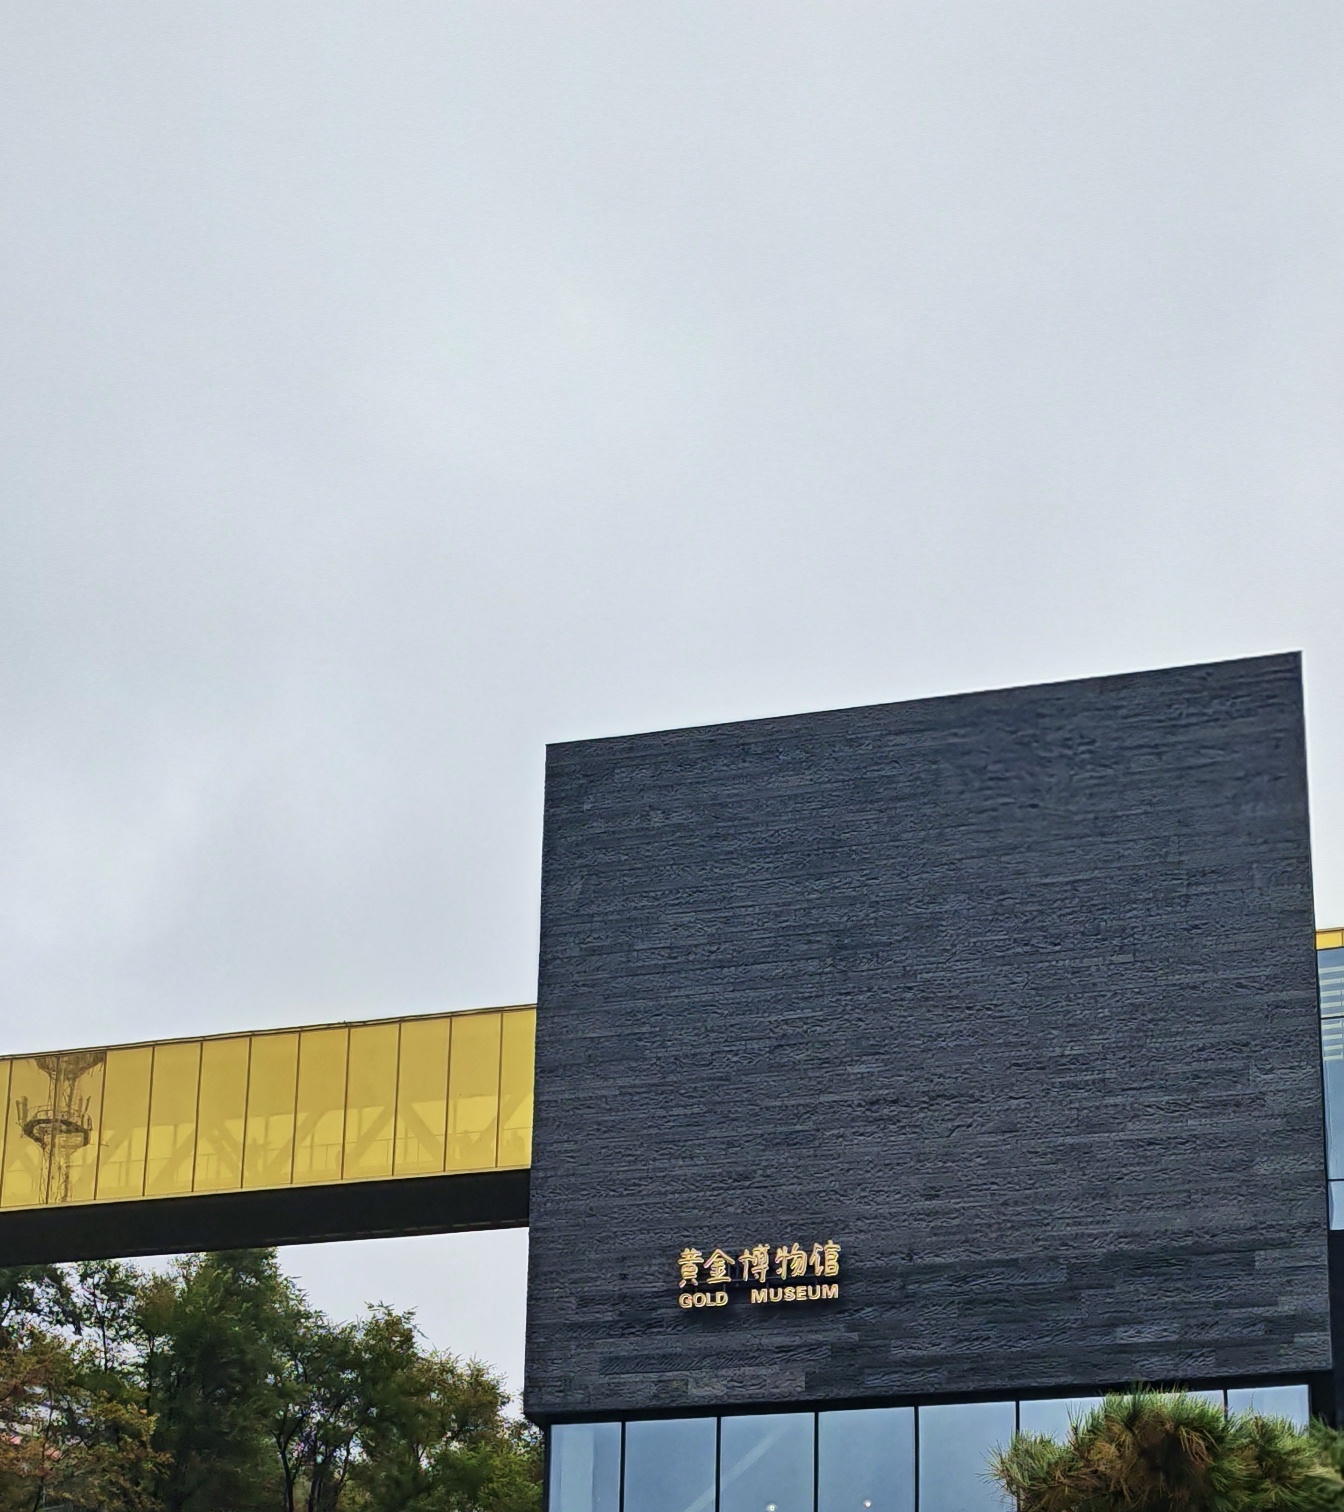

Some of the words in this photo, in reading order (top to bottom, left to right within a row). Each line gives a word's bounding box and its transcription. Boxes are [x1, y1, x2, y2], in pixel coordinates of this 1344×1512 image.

[677, 1239, 841, 1288] 黄金博物馆
[678, 1291, 729, 1309] GOLD
[750, 1283, 839, 1304] MUSEUM
